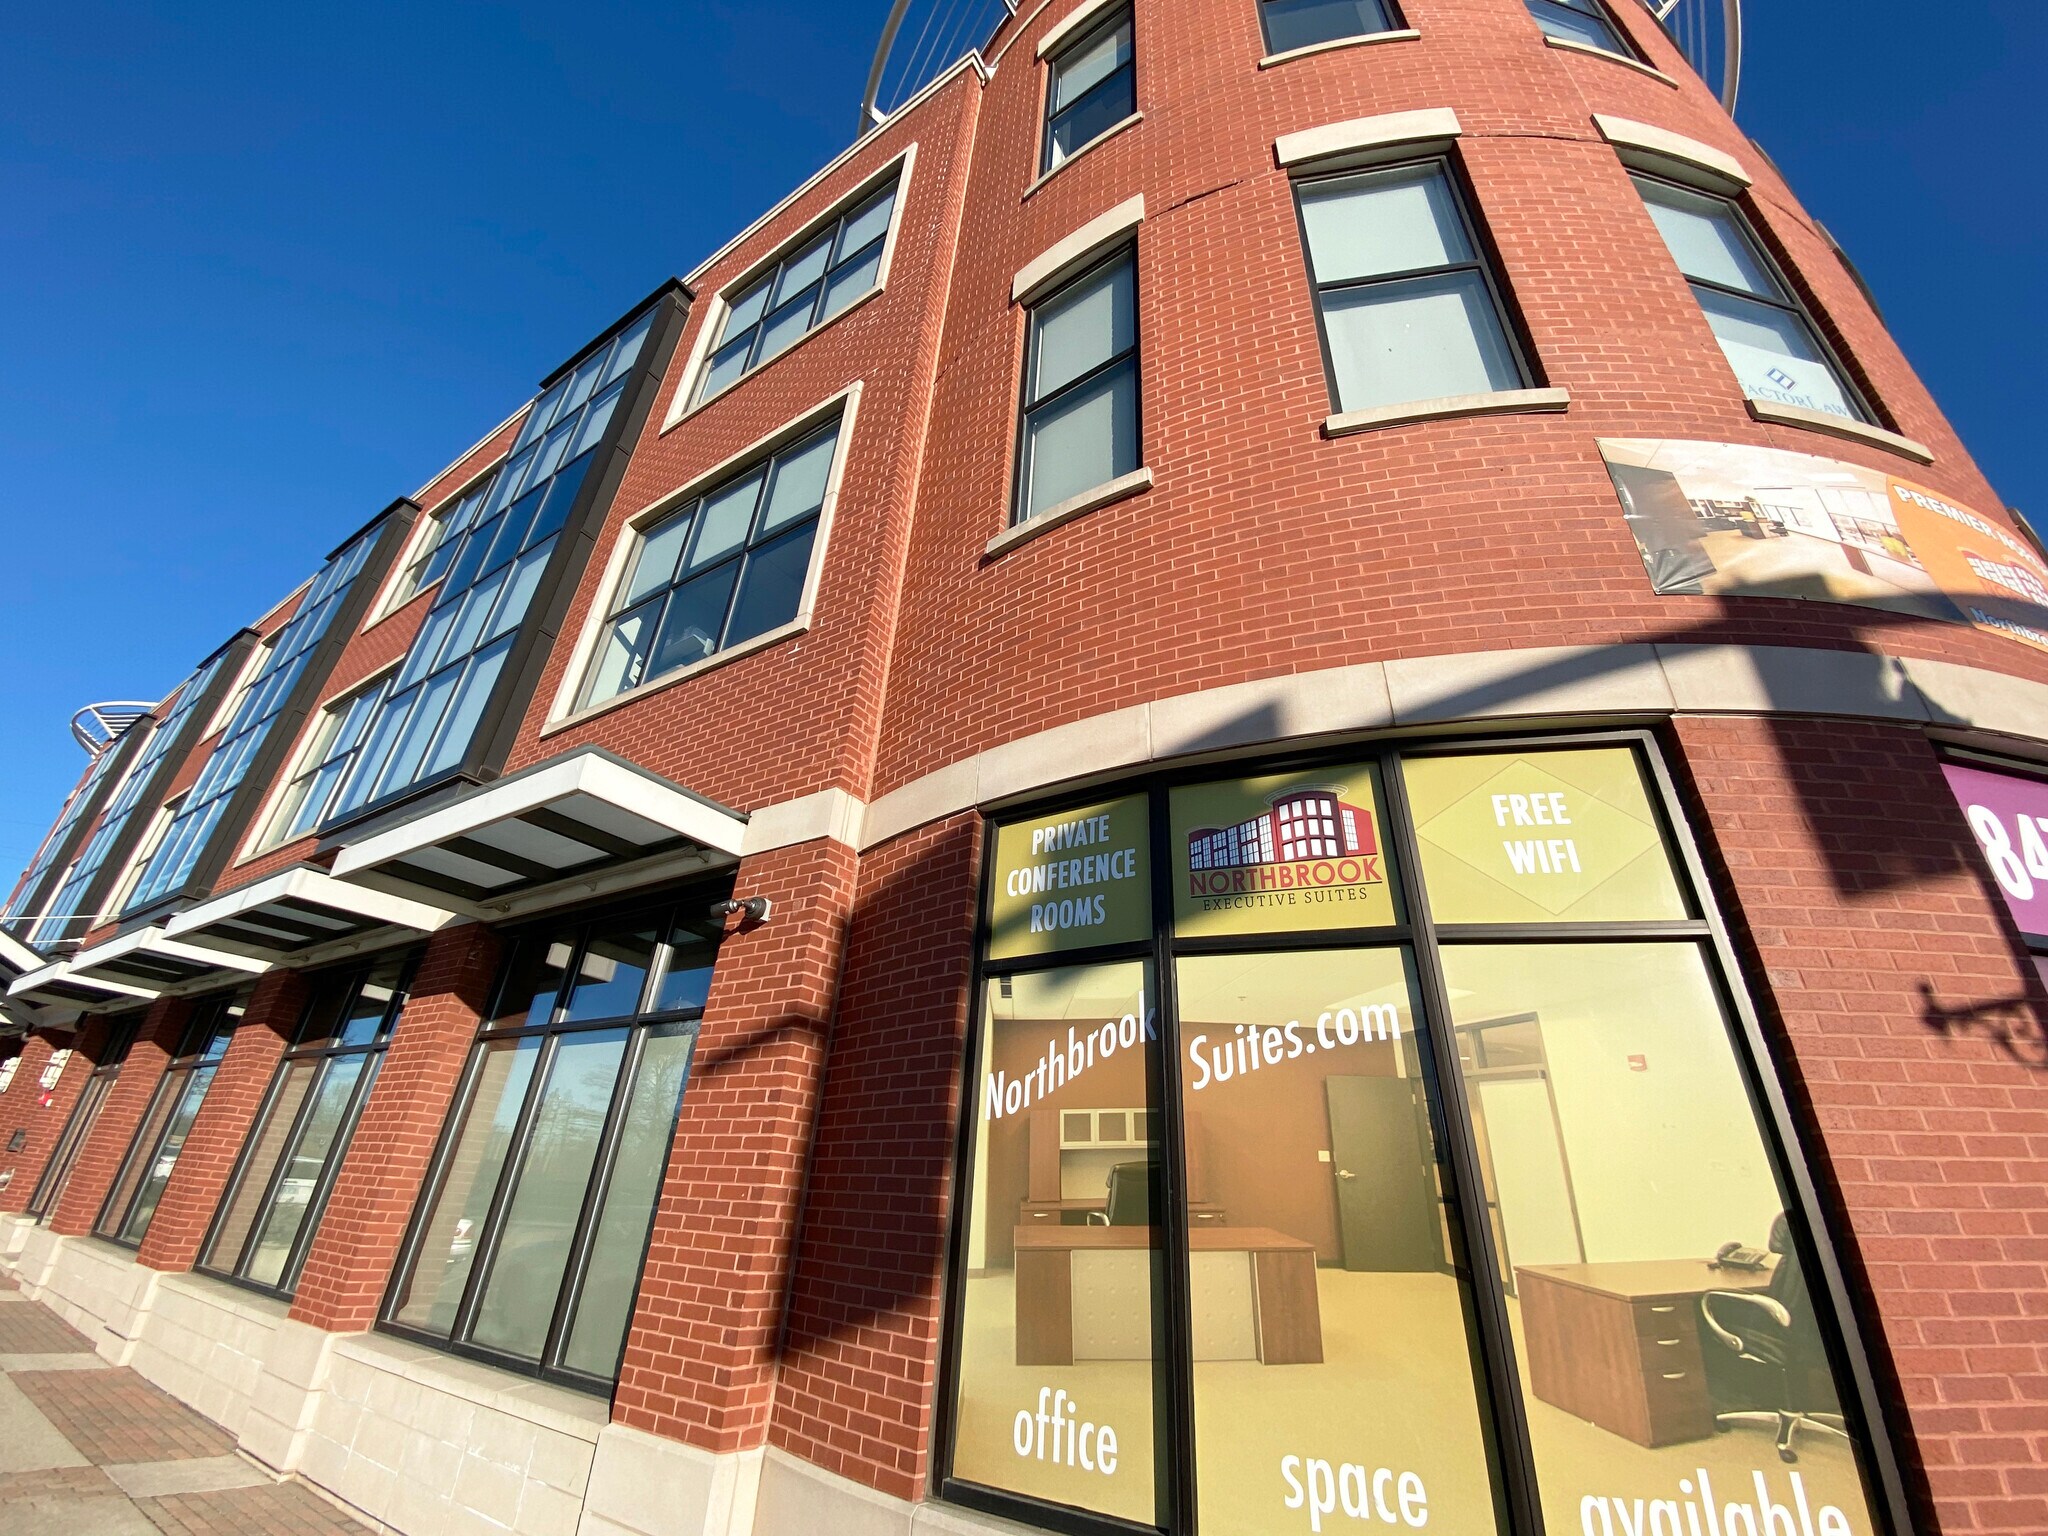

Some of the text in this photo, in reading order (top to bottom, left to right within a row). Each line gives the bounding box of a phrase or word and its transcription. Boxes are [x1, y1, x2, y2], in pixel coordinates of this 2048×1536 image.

[1892, 484, 1998, 541] PREMIER
[1491, 791, 1572, 827] FREE
[1031, 814, 1110, 856] PRIVATE
[1006, 848, 1136, 898] CONFERENCE
[1190, 856, 1383, 896] NORTHBROOK
[1502, 838, 1582, 875] WIFI
[1029, 894, 1106, 934] ROOMS
[1203, 887, 1368, 911] EXECUTIVE SUITES
[983, 990, 1401, 1121] Northbrook Suites.com
[1012, 1385, 1118, 1475] office
[1279, 1453, 1428, 1533] space
